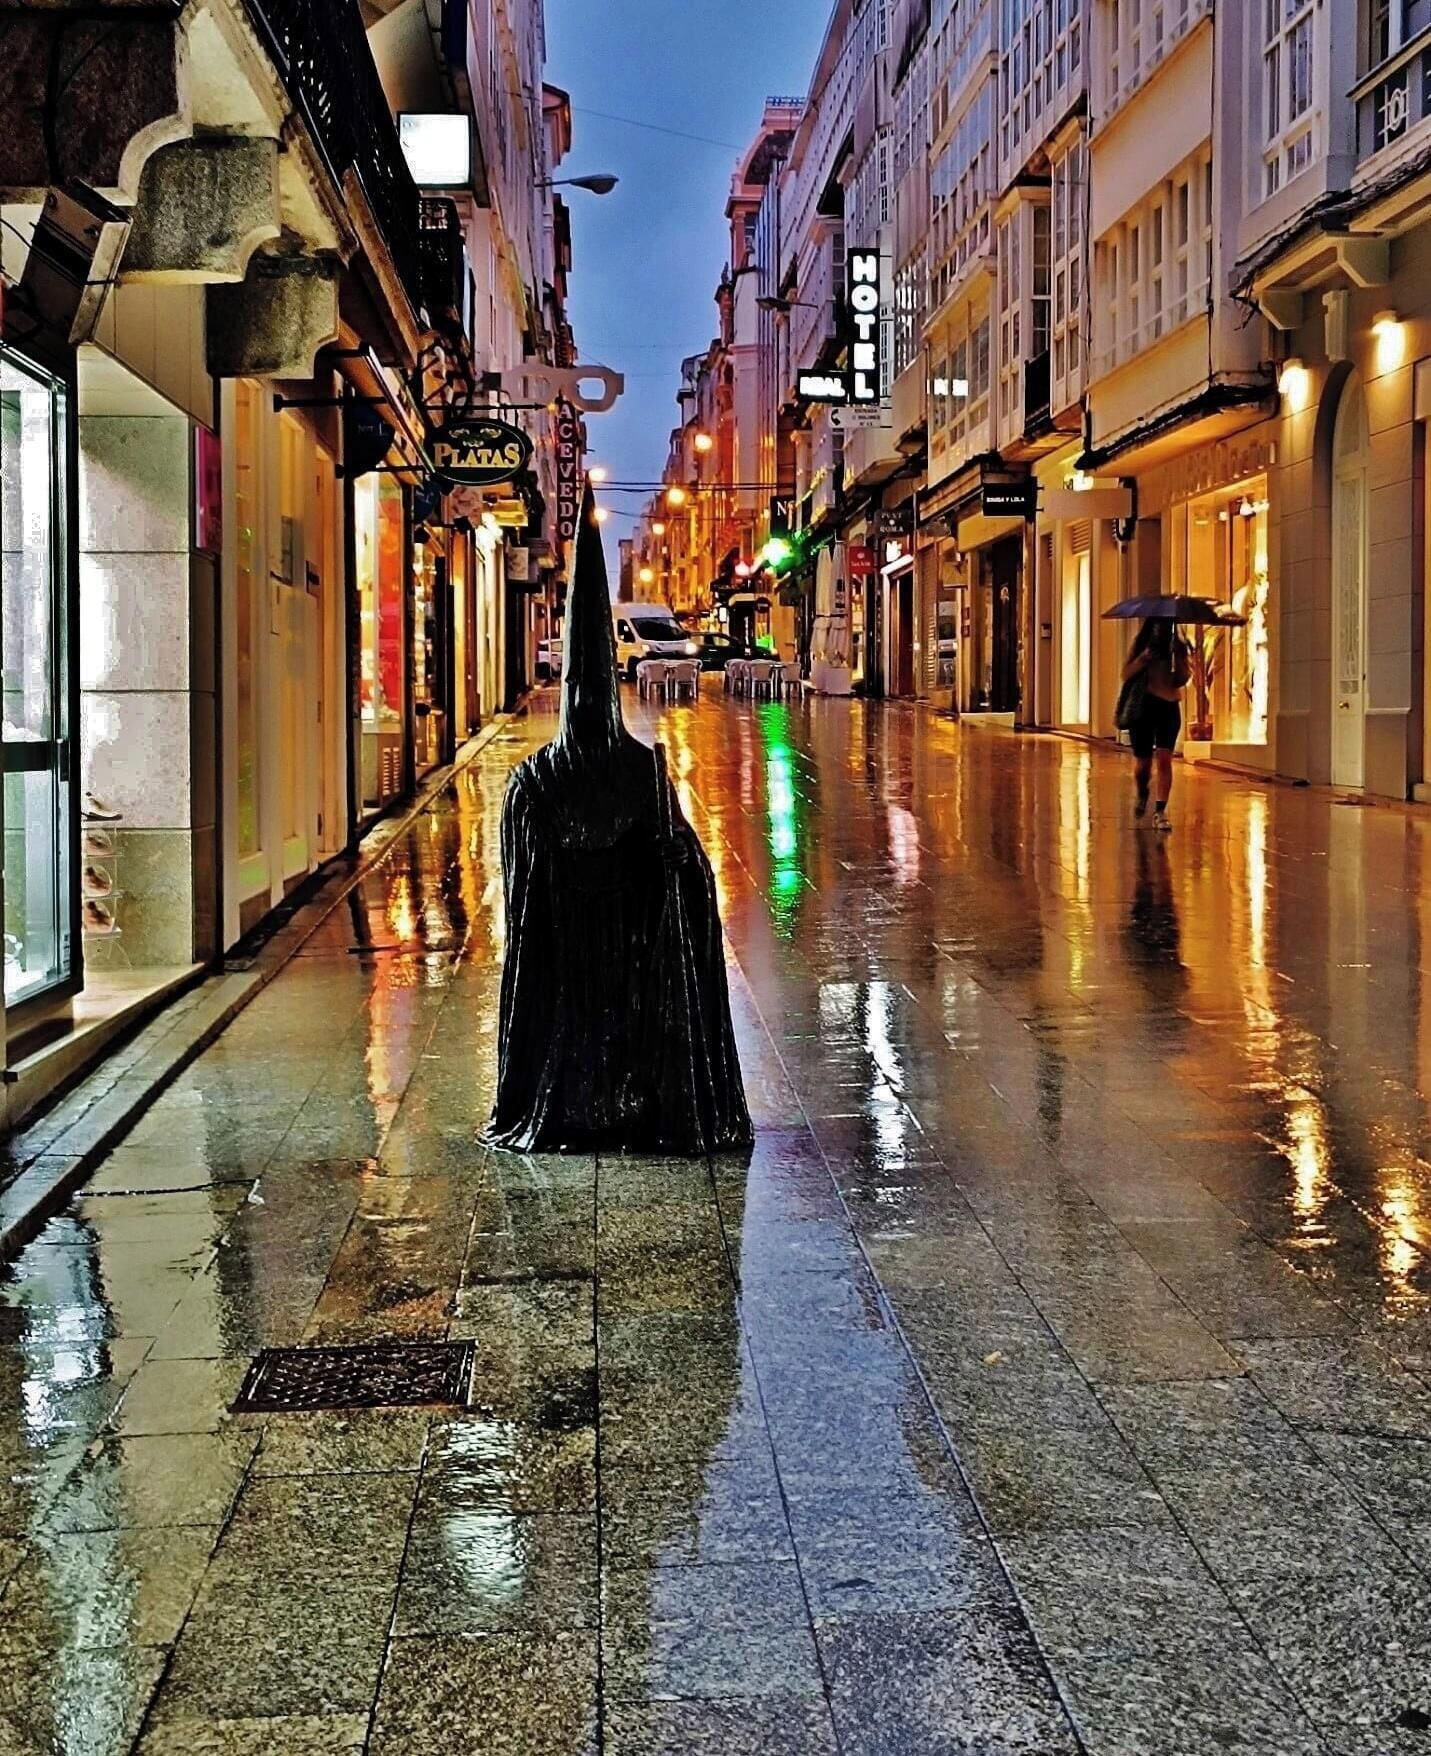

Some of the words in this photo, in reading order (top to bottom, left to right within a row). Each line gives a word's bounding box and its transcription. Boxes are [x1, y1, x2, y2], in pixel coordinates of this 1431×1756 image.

[852, 255, 878, 398] HOTEL
[432, 443, 520, 468] PLATAS
[559, 405, 574, 536] ACEVEDO
